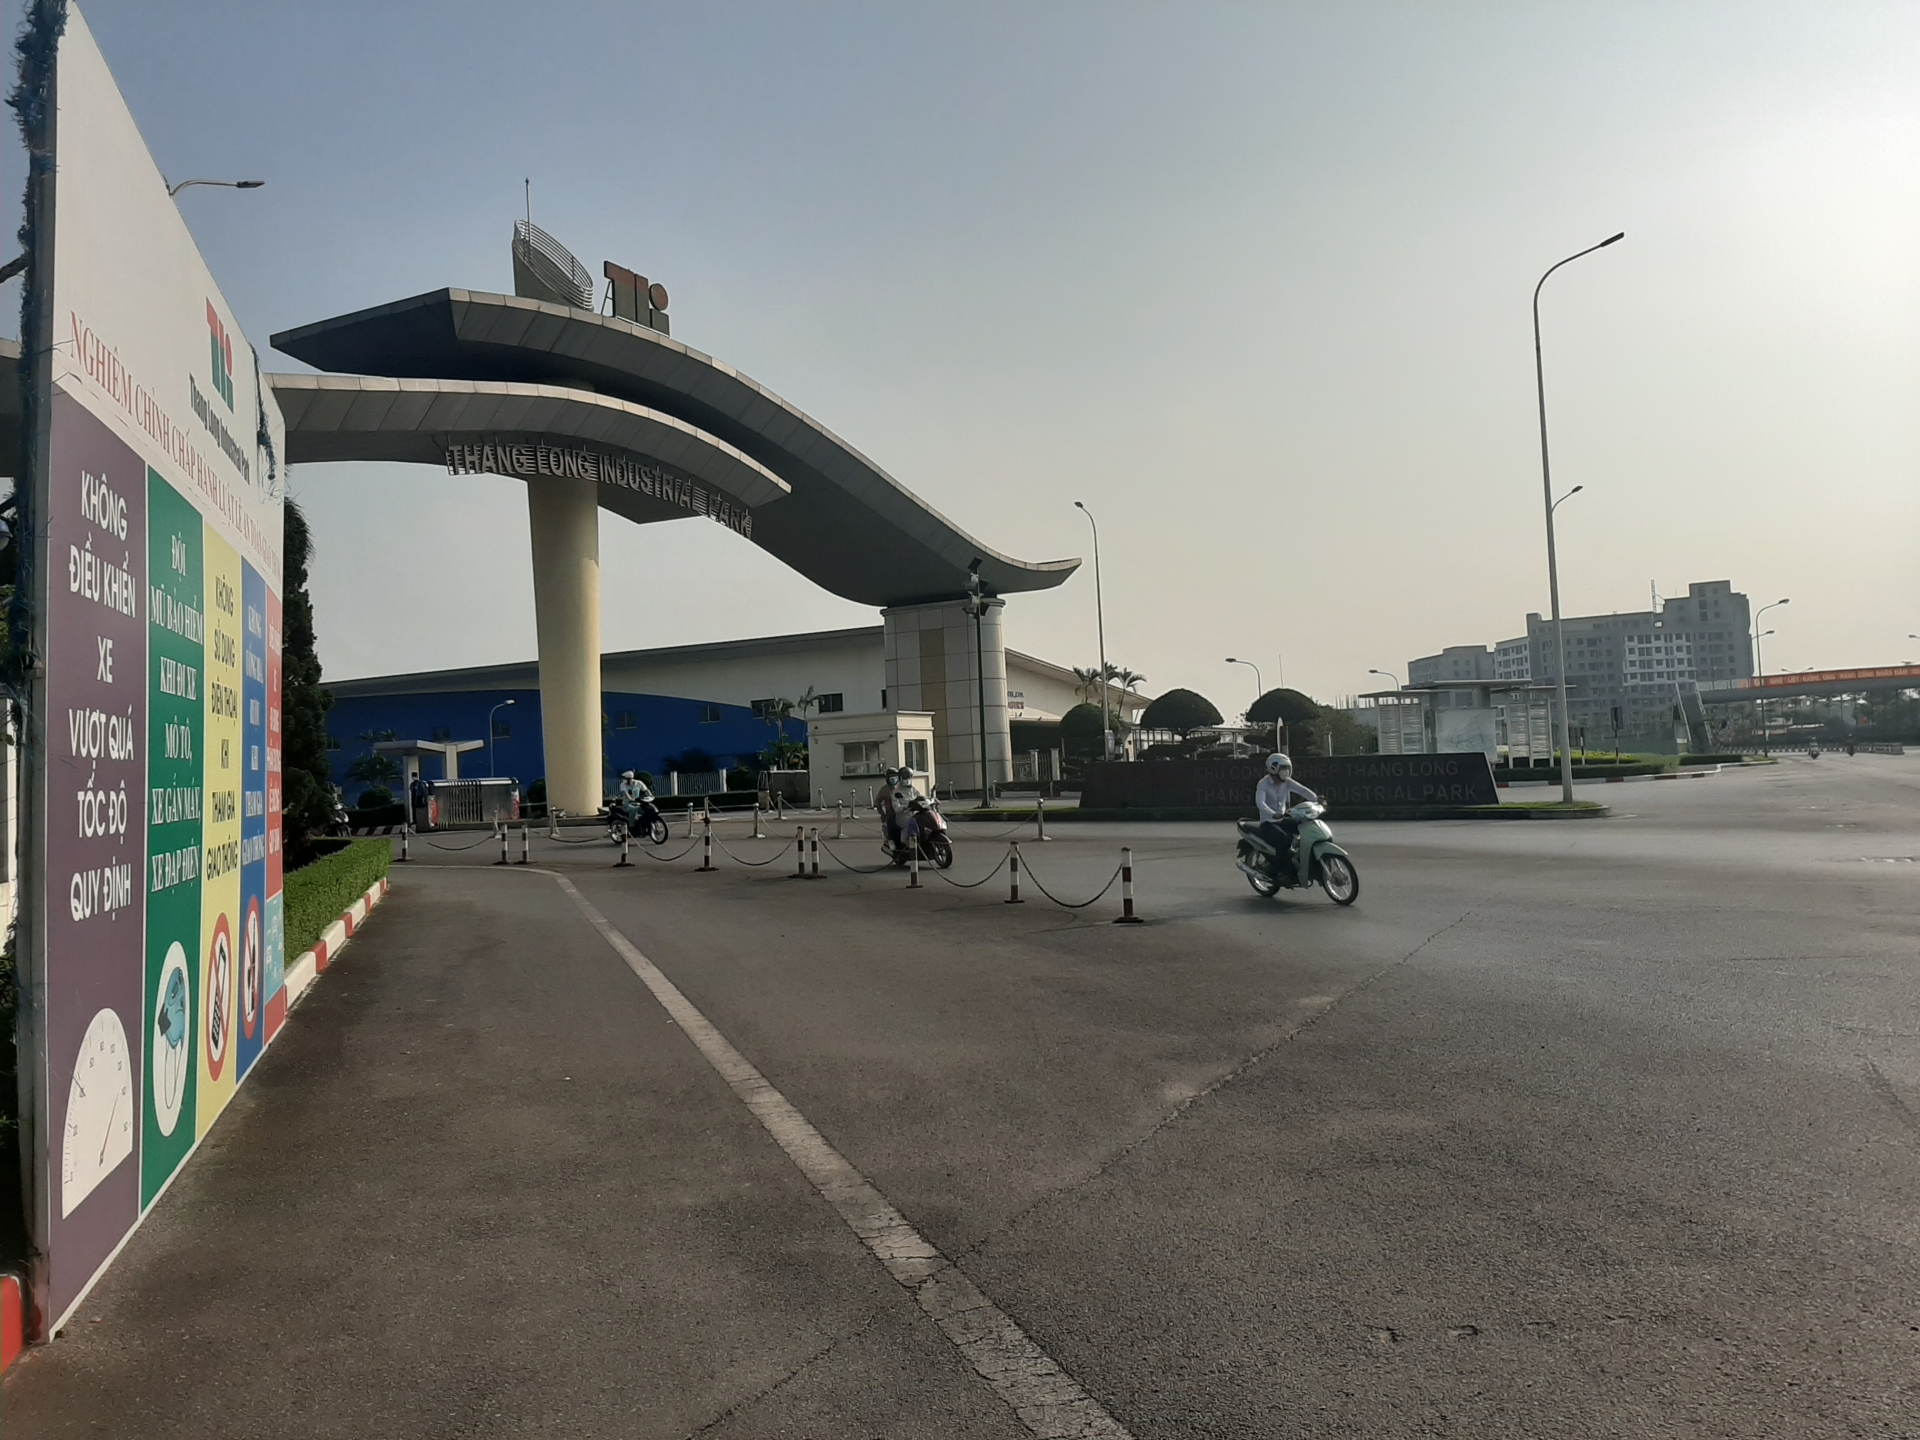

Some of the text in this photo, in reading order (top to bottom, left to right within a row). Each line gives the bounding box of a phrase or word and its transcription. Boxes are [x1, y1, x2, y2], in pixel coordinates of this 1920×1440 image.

[70, 310, 132, 416] NGHIÊM
[135, 387, 170, 454] CHỈNH
[81, 470, 128, 541] KHÔNG
[446, 443, 753, 540] THANG LONG INDUSTRIAL PARK
[69, 531, 136, 618] ĐIỀU KHIỂN
[171, 531, 186, 583] ĐỘI
[150, 584, 203, 646] MŨ BẢO HIỂM
[97, 635, 113, 684] XE
[160, 656, 197, 701] KHI ĐI XE
[68, 704, 134, 770] VƯỢT QUÁ
[165, 715, 193, 766] MÔ TÔ,
[151, 773, 201, 825] XE GẮN MÁY,
[1193, 766, 1225, 781] KHU
[1409, 760, 1459, 777] LONG
[1313, 784, 1418, 803] NDUSTRIAL
[1422, 783, 1477, 801] PARK
[77, 772, 127, 845] TỐC ĐỘ
[70, 856, 131, 922] QUY ĐỊNH
[151, 838, 200, 895] XE ĐẠP ĐIỆN
